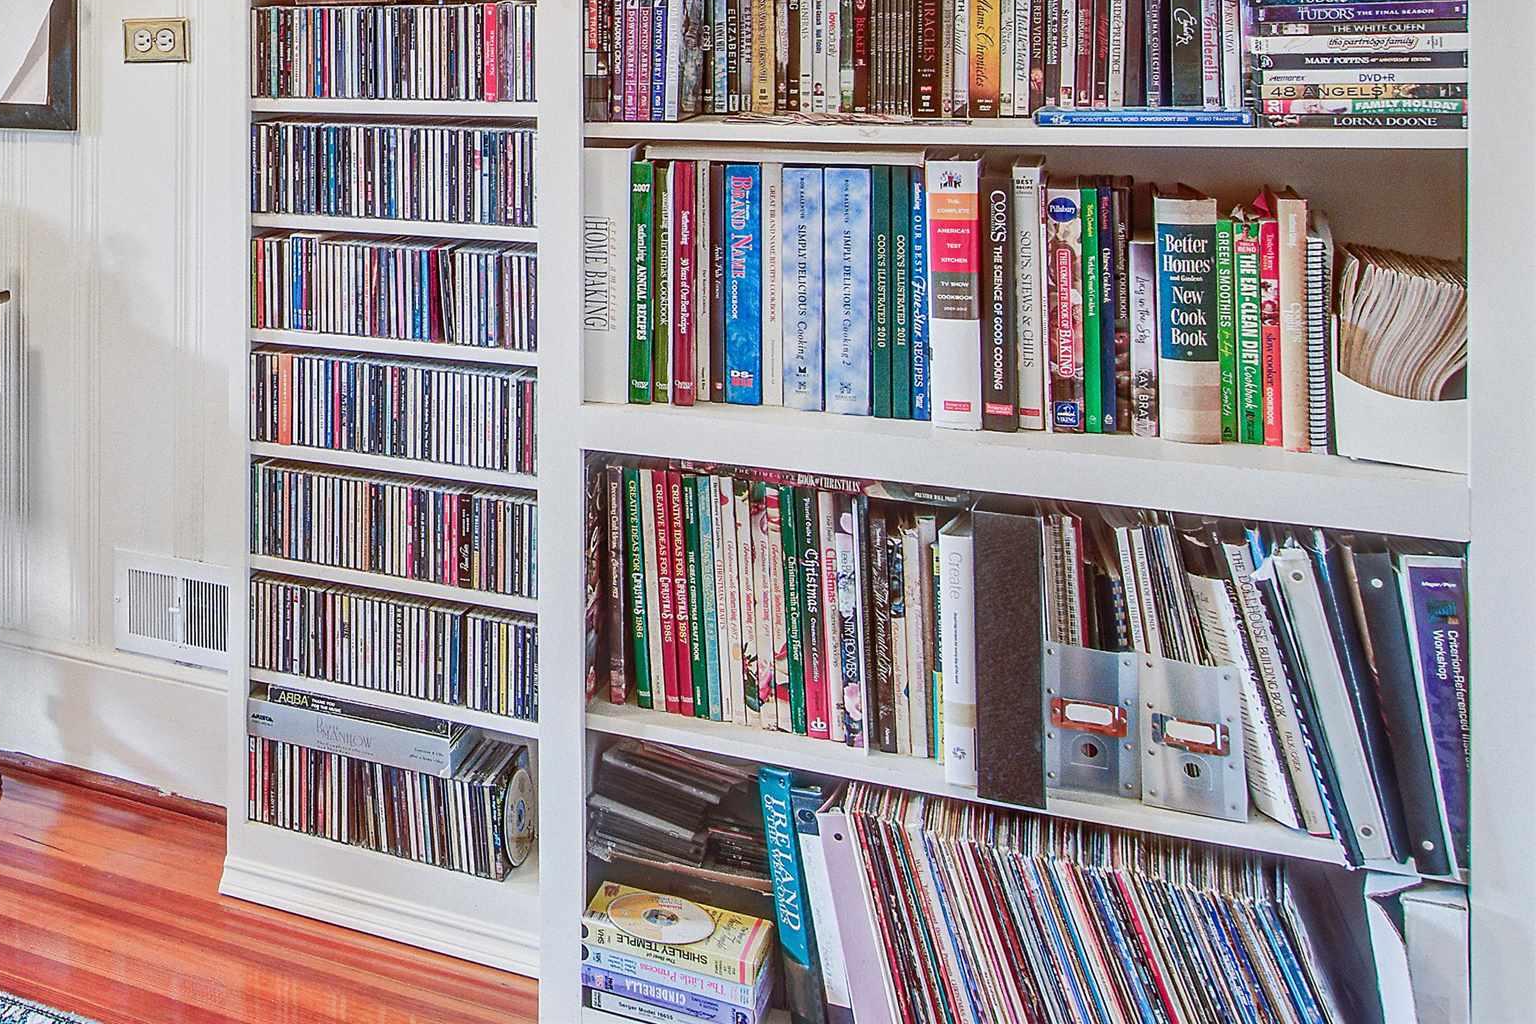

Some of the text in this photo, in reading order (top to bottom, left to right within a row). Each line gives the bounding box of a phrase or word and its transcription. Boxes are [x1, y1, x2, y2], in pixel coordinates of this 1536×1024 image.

[589, 15, 598, 45] TRACE
[628, 10, 637, 51] DOWNTON
[642, 10, 650, 50] DOWNTON
[1033, 5, 1041, 25] RED
[1298, 9, 1355, 20] TUDORS
[1331, 23, 1425, 32] THE WHITE QUEEN
[654, 9, 664, 77] DOWNTON ABBEY
[702, 25, 713, 51] crash
[727, 8, 737, 74] ELIZABETH
[1032, 26, 1041, 59] VIOLIN
[1304, 56, 1370, 65] MARY POPPINS
[1358, 73, 1396, 83] DVD+R
[1270, 85, 1384, 98] 48 ANGELS
[1354, 100, 1460, 111] FAMILY HOLIDAY
[1333, 116, 1438, 126] LORNA DOONE
[632, 183, 651, 193] 2007
[730, 176, 753, 231] BRAND
[1049, 203, 1077, 216] Pillsbury
[936, 227, 971, 235] AMERICA'S
[1020, 230, 1032, 268] SOUPS,
[1164, 233, 1209, 253] Better
[584, 220, 610, 328] HOME BAKING
[730, 235, 753, 279] NAME
[843, 230, 851, 315] SIMPLY DELICIOUS
[1059, 251, 1068, 265] THE
[1163, 256, 1211, 274] Homes
[796, 224, 807, 360] SIMPLY DELICIOUS Cooking
[877, 234, 886, 348] COOK'S ILLUSTRATED 2010
[896, 234, 906, 346] COOK'S ILLUSTRATED 2011
[936, 293, 974, 302] COOKBOOK
[940, 280, 969, 288] TV SHOW
[990, 189, 1007, 390] COOK'S THE SCIENCE OF GOOD COOKING
[1021, 273, 1033, 312] STEWS
[1059, 265, 1069, 302] COMPLETE
[1119, 272, 1128, 319] COOKBOOK
[1171, 286, 1205, 305] New
[1218, 231, 1231, 328] GREEN SMOOTHIES
[636, 264, 647, 341] ANNUAL RECIPES
[914, 215, 924, 387] OUR BEST RECIPES
[1170, 309, 1207, 326] Cook
[1240, 253, 1260, 366] THE EAT-CLEAN DIET
[1023, 329, 1034, 368] CHILIS
[1059, 329, 1073, 375] BAKING
[1170, 329, 1208, 347] Book
[1138, 369, 1149, 390] KAY
[797, 474, 861, 492] BOOK CHRISTMAS
[628, 480, 645, 615] CREATIVE IDEAS FOR CHRISTMAS
[655, 484, 673, 620] CREATIVE IDEAS FOR CHRISTMAS
[671, 484, 689, 645] CREATIVE IDEAS FOR CHRISTMAS 1987
[688, 563, 696, 584] GREAT
[802, 548, 819, 613] Christmas
[825, 547, 837, 603] Christmas
[948, 551, 964, 600] Create
[689, 584, 698, 621] CHRISTMAS
[691, 621, 699, 641] CRAFT
[1231, 550, 1287, 719] THE BUILDING BOOK
[844, 638, 857, 679] FLOWERS
[1432, 629, 1449, 680] Workshop
[278, 690, 310, 706] ABBA
[764, 794, 775, 811] OF
[766, 816, 778, 844] THE
[772, 795, 801, 931] IRELAND
[616, 933, 708, 965] SHIRLEY TEMPLE
[624, 979, 687, 1005] CINDERELLA
